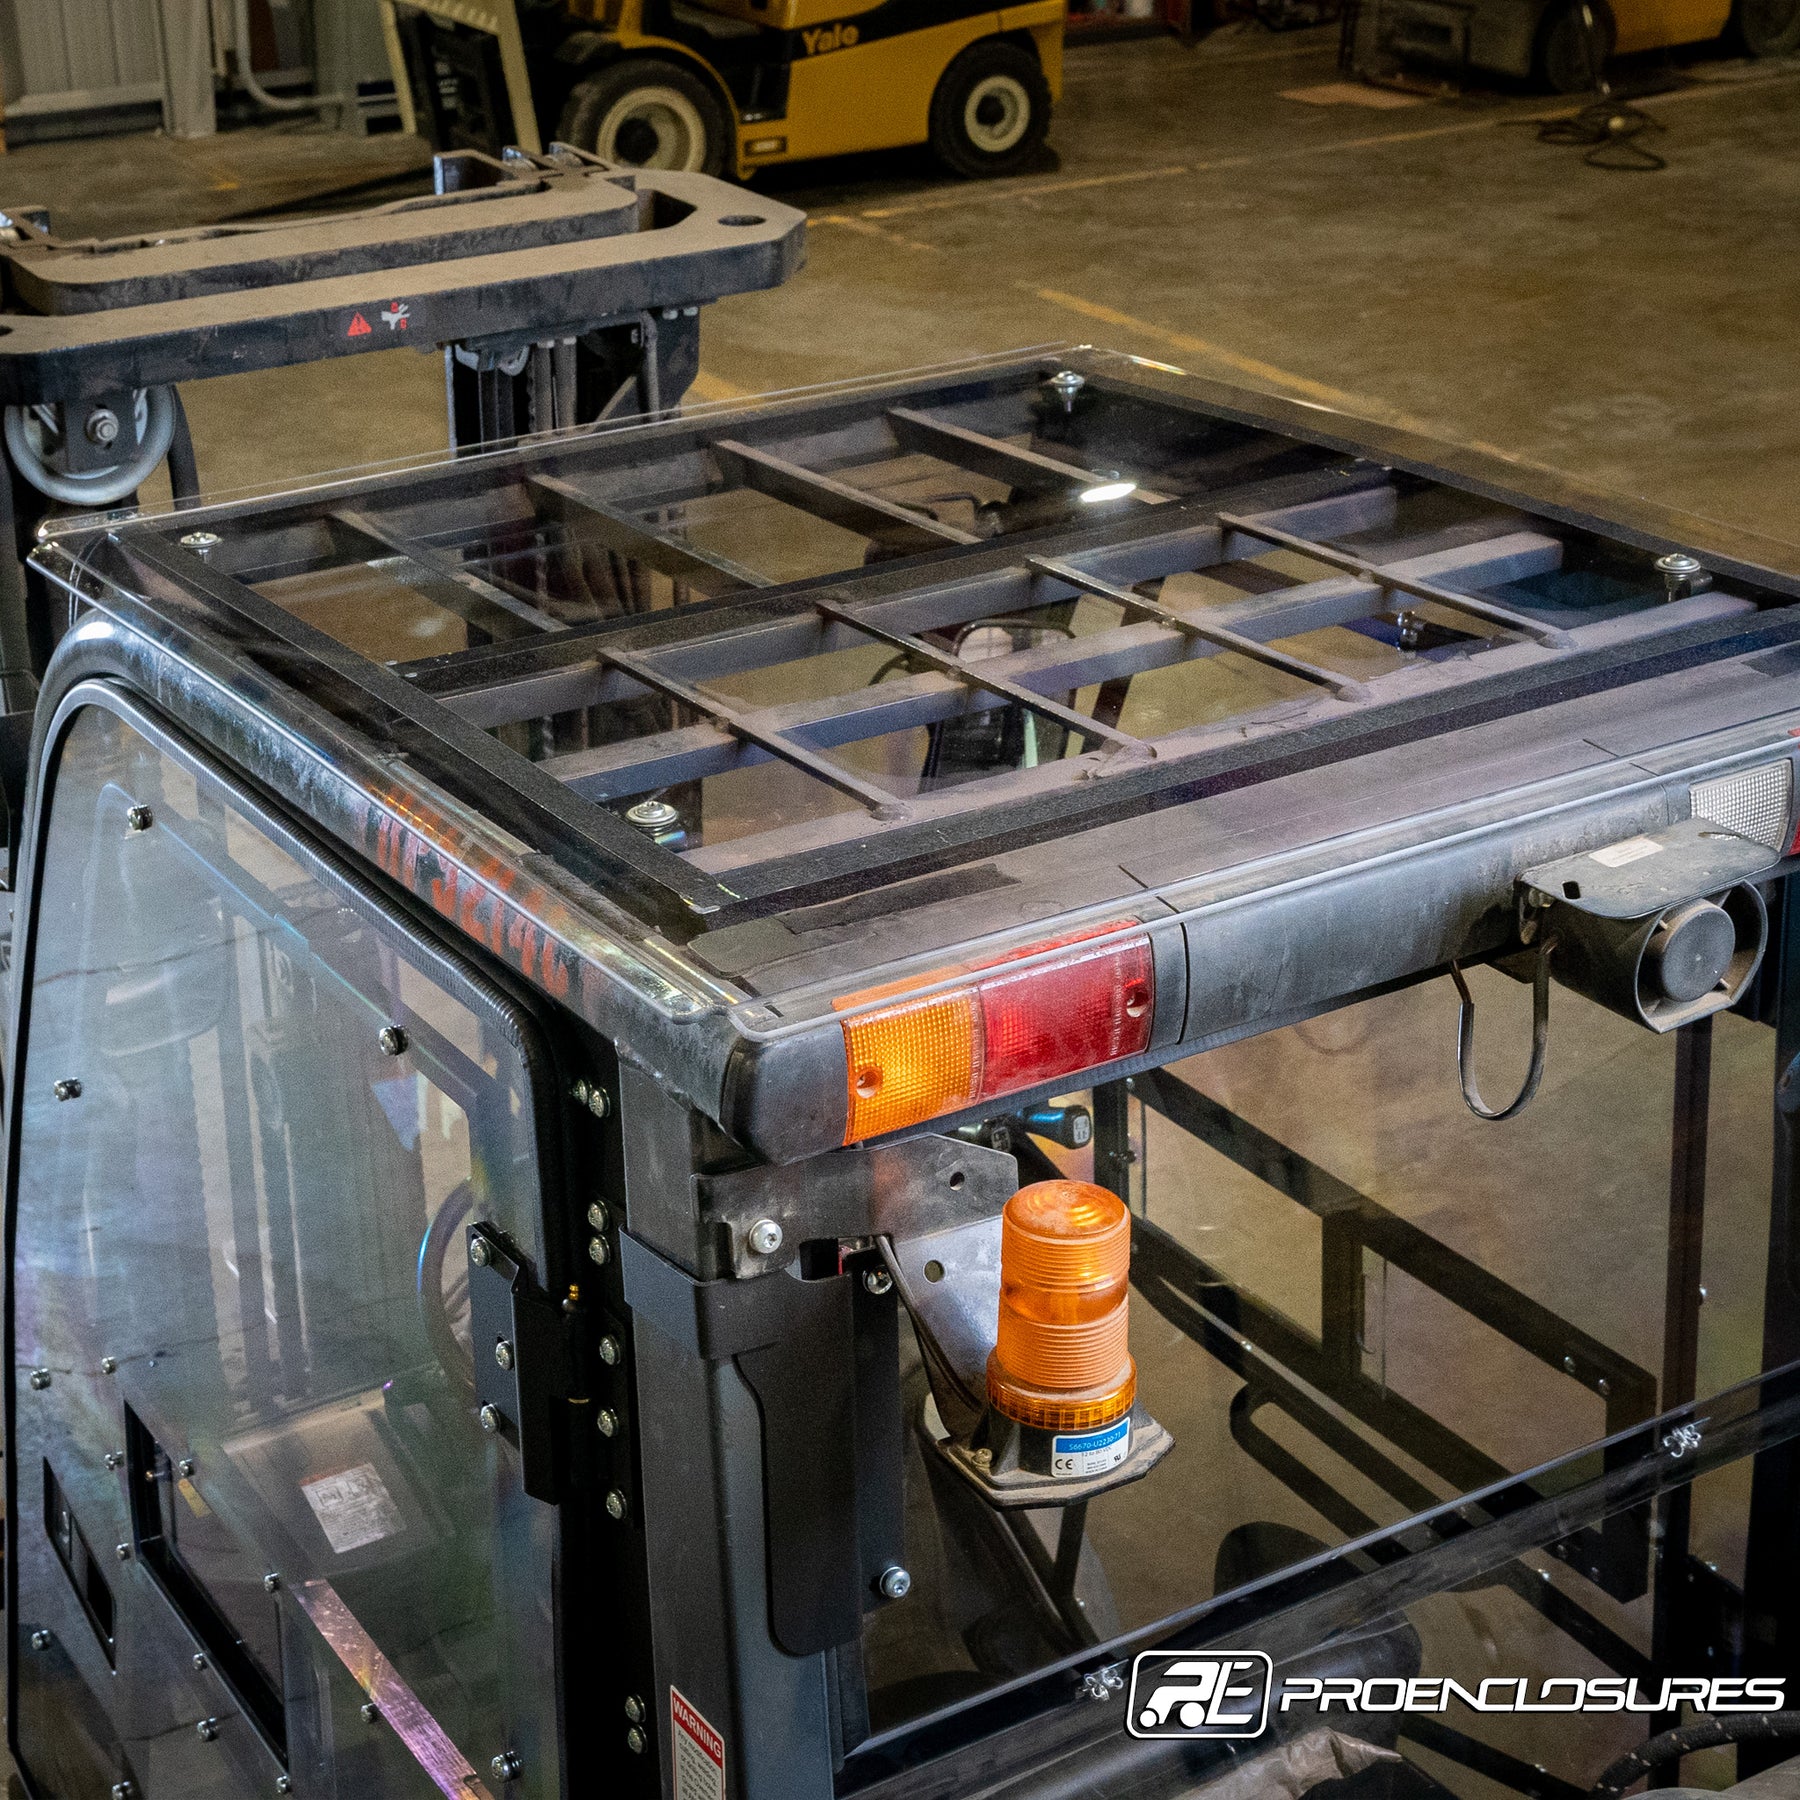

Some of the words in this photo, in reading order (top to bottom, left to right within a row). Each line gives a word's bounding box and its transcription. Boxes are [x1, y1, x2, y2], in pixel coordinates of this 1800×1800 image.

[801, 23, 859, 55] Yale
[1055, 1459, 1073, 1470] CE
[673, 1697, 722, 1759] WARNING
